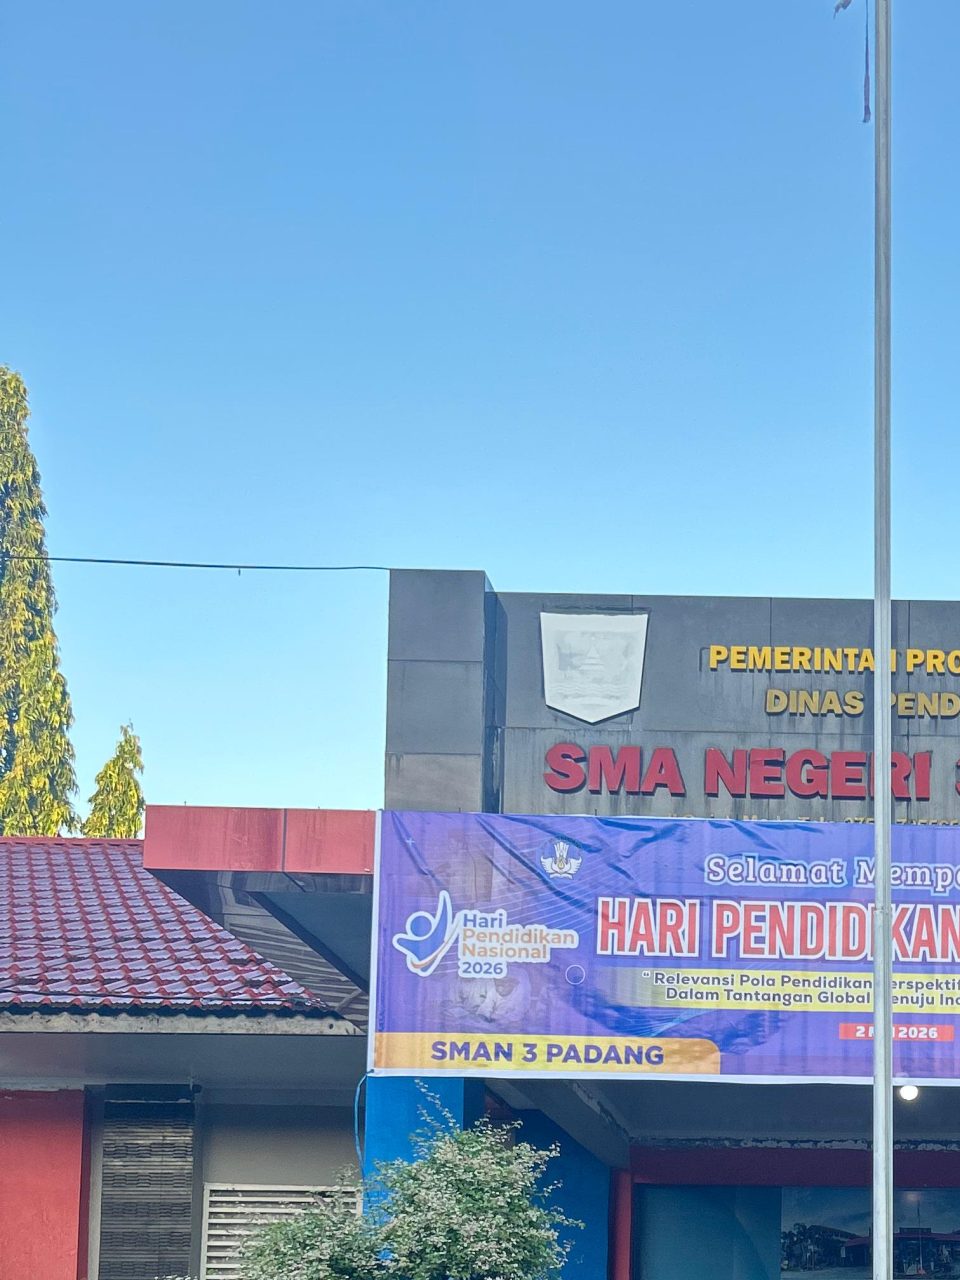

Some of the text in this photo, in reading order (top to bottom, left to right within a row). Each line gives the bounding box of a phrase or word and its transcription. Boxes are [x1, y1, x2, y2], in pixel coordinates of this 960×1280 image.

[709, 645, 897, 673] PEMERINTA
[765, 688, 865, 716] DINAS
[544, 743, 685, 797] SMA
[705, 747, 932, 801] NEGERI
[706, 855, 847, 886] Selamat
[463, 913, 504, 929] Hari
[599, 898, 698, 956] HARI
[462, 928, 575, 944] Pendidikan
[462, 943, 547, 959] Nasional
[462, 961, 504, 975] 2026
[654, 973, 735, 987] Relevansi
[740, 974, 776, 987] Pola
[781, 975, 872, 989] Pendidikan
[666, 988, 719, 1001] Dalam
[724, 989, 813, 1006] Tantangan
[818, 991, 871, 1004] Global
[891, 993, 935, 1007] enuju
[855, 1025, 866, 1037] 2
[898, 1026, 938, 1039] 2026
[431, 1040, 665, 1065] SMAN 3 PADANG
